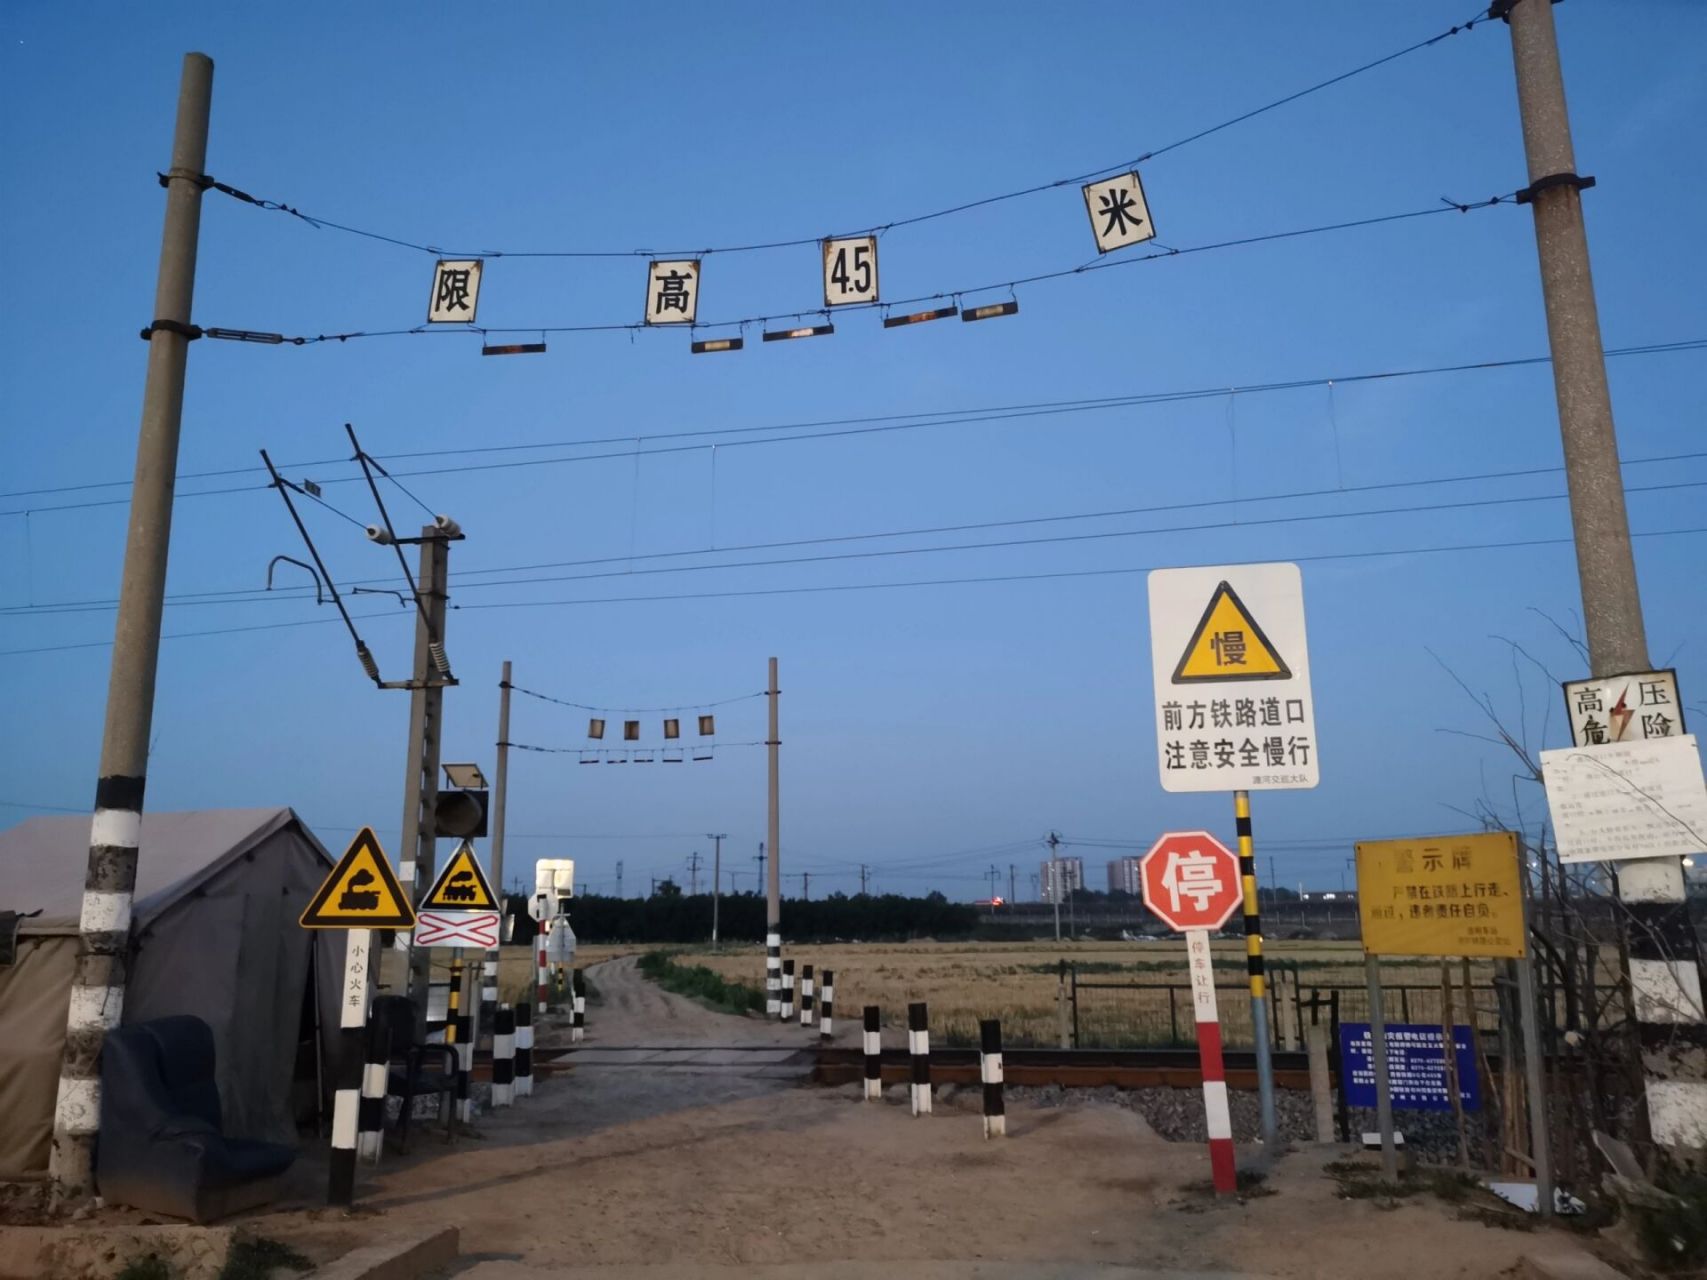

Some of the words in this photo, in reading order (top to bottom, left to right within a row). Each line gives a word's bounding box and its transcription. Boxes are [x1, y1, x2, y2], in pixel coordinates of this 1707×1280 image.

[1098, 188, 1143, 237] 米
[435, 269, 470, 313] 限
[655, 269, 693, 314] 高
[831, 246, 871, 294] 4.5
[1210, 630, 1247, 666] 慢
[1162, 696, 1305, 731] 前方铁路道口
[1574, 679, 1671, 715] 高压
[1165, 736, 1311, 770] 注意安全慢行
[1161, 849, 1223, 912] 停
[348, 945, 365, 1007] 小心火车
[1192, 941, 1211, 1004] 停车让行
